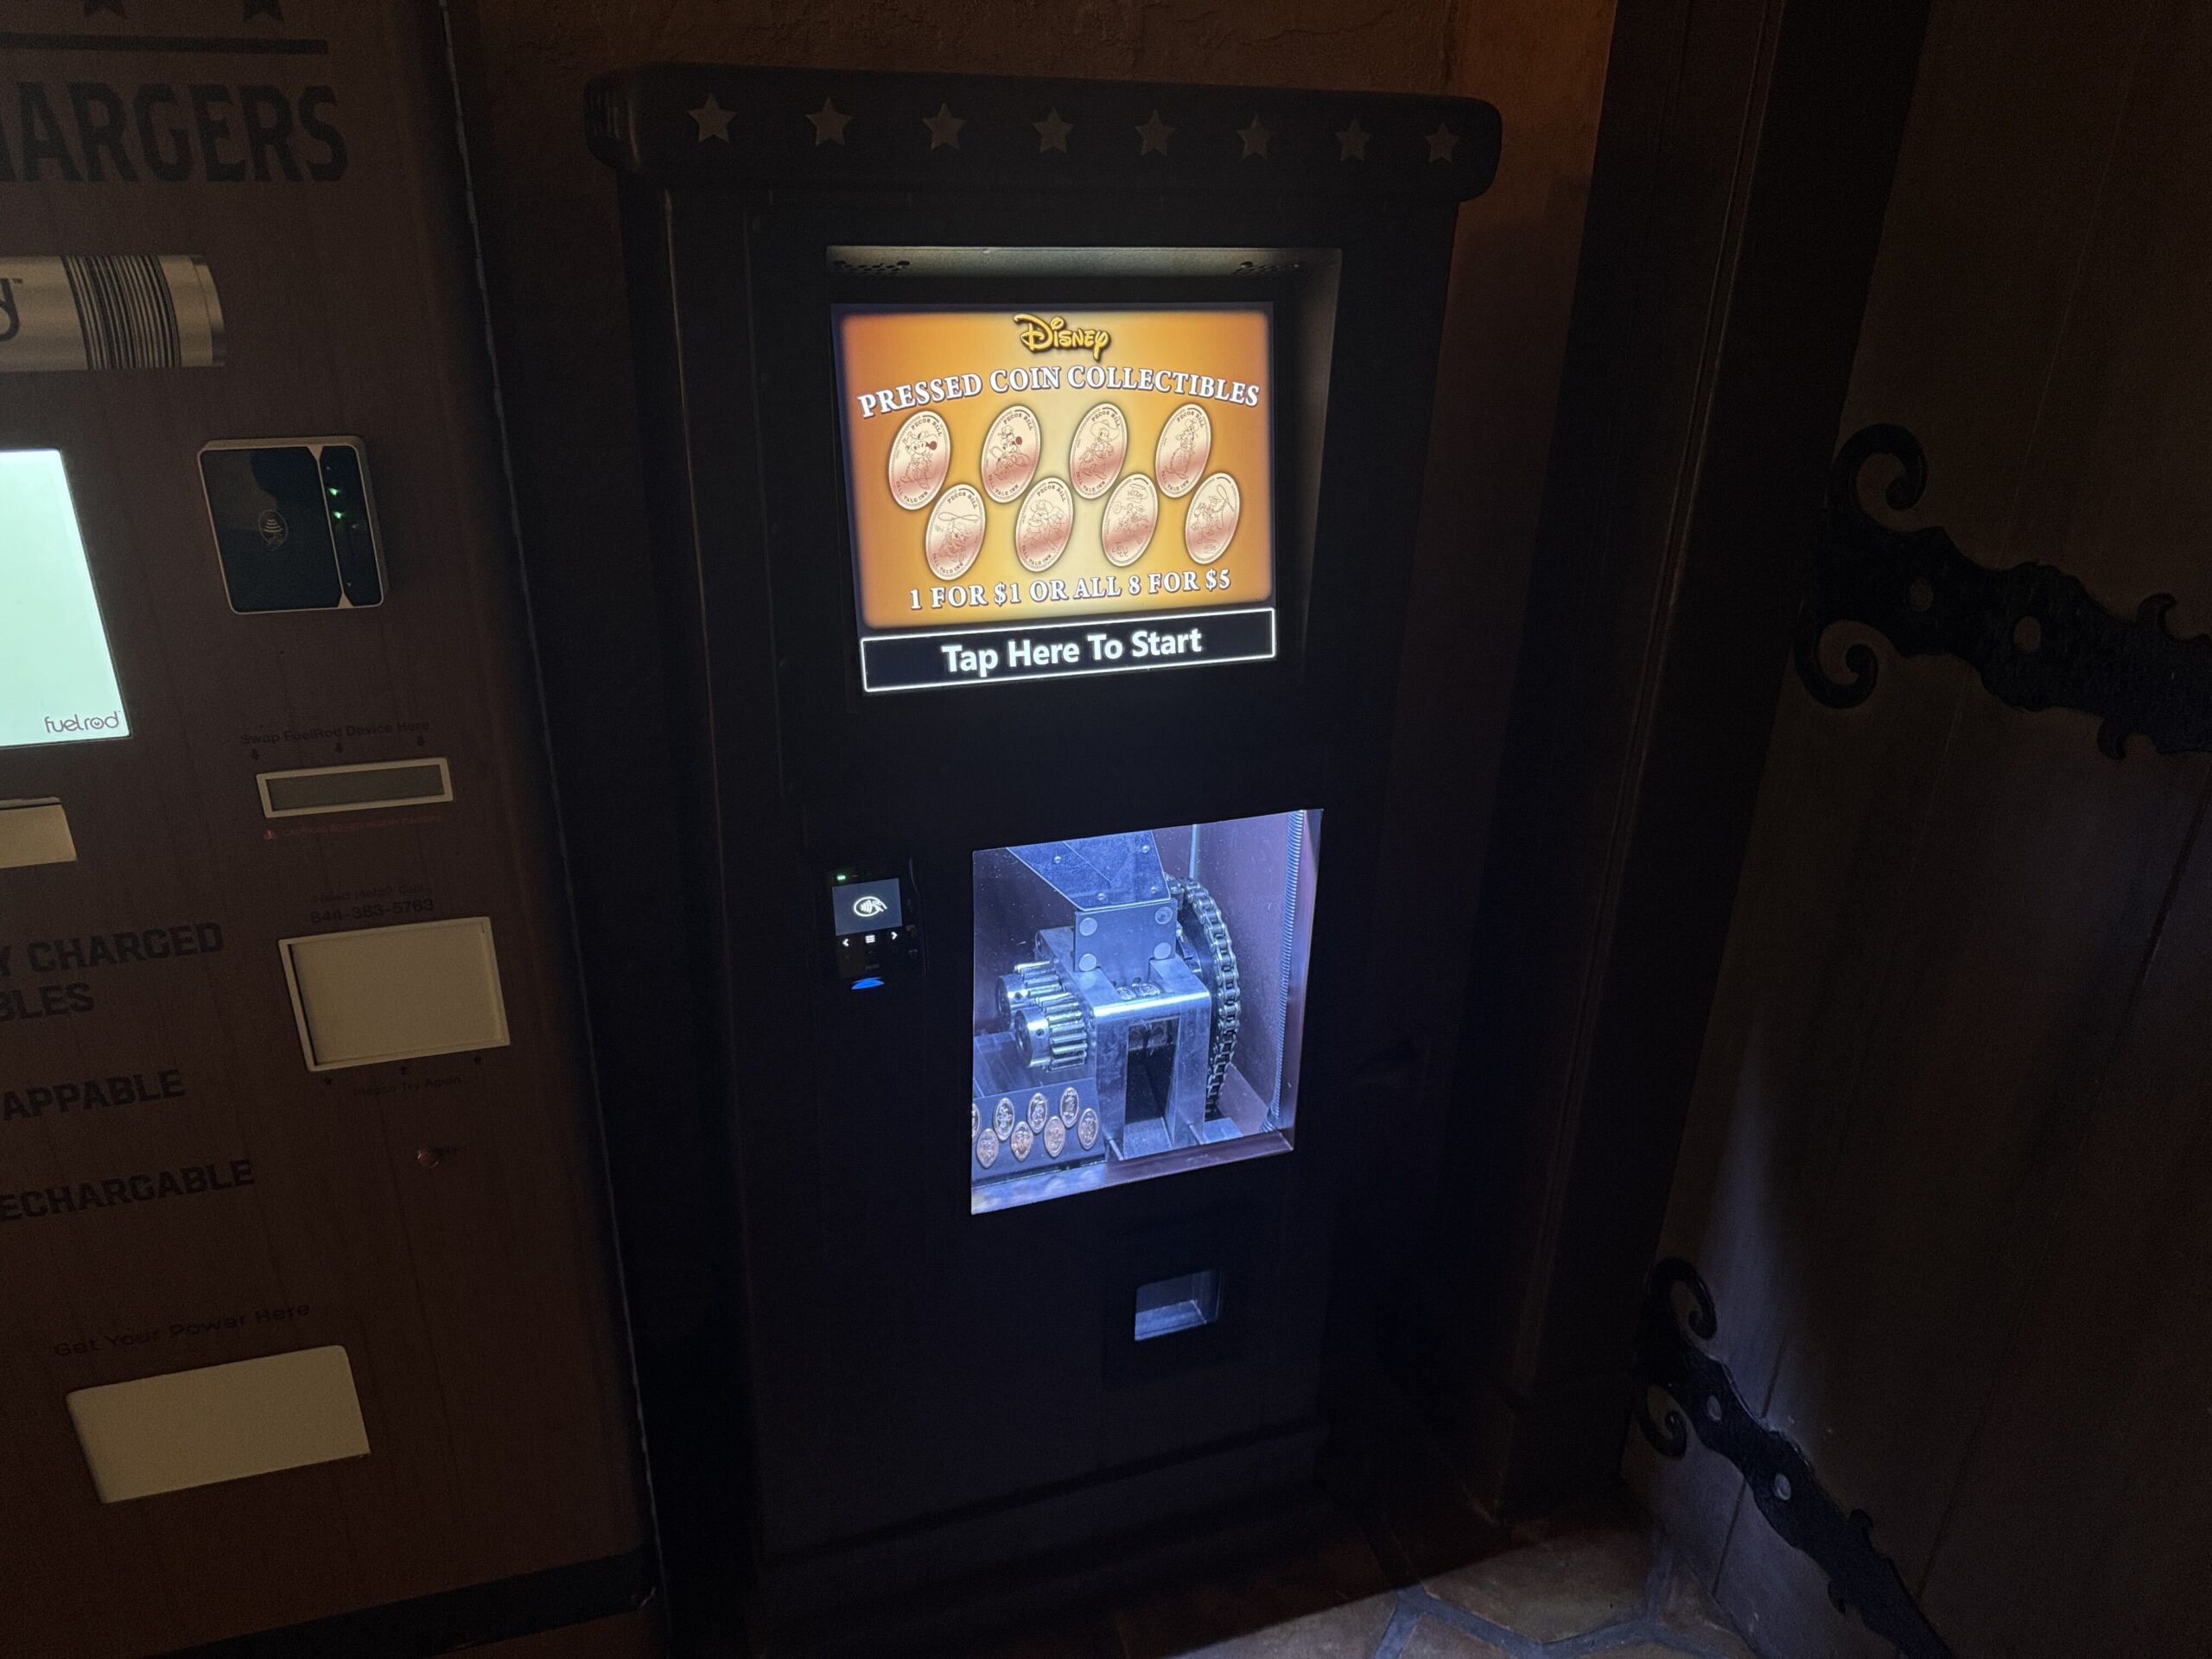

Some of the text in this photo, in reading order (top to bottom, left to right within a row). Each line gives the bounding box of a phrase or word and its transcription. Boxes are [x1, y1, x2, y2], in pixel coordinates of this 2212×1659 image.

[0, 81, 348, 182] ARGERS
[857, 365, 1260, 418] PRESSED COIN COLLECTIBLES
[910, 568, 1231, 610] 1 FOR $1 OR ALL 8 FOR $5
[941, 628, 1202, 677] Tap Here To Start
[44, 710, 119, 733] fuelrod
[27, 922, 225, 973] CHARGED
[3, 1069, 186, 1121] APPABLE
[0, 1159, 256, 1222] ECHARGABLE
[54, 1302, 309, 1357] Get Your Power Here
